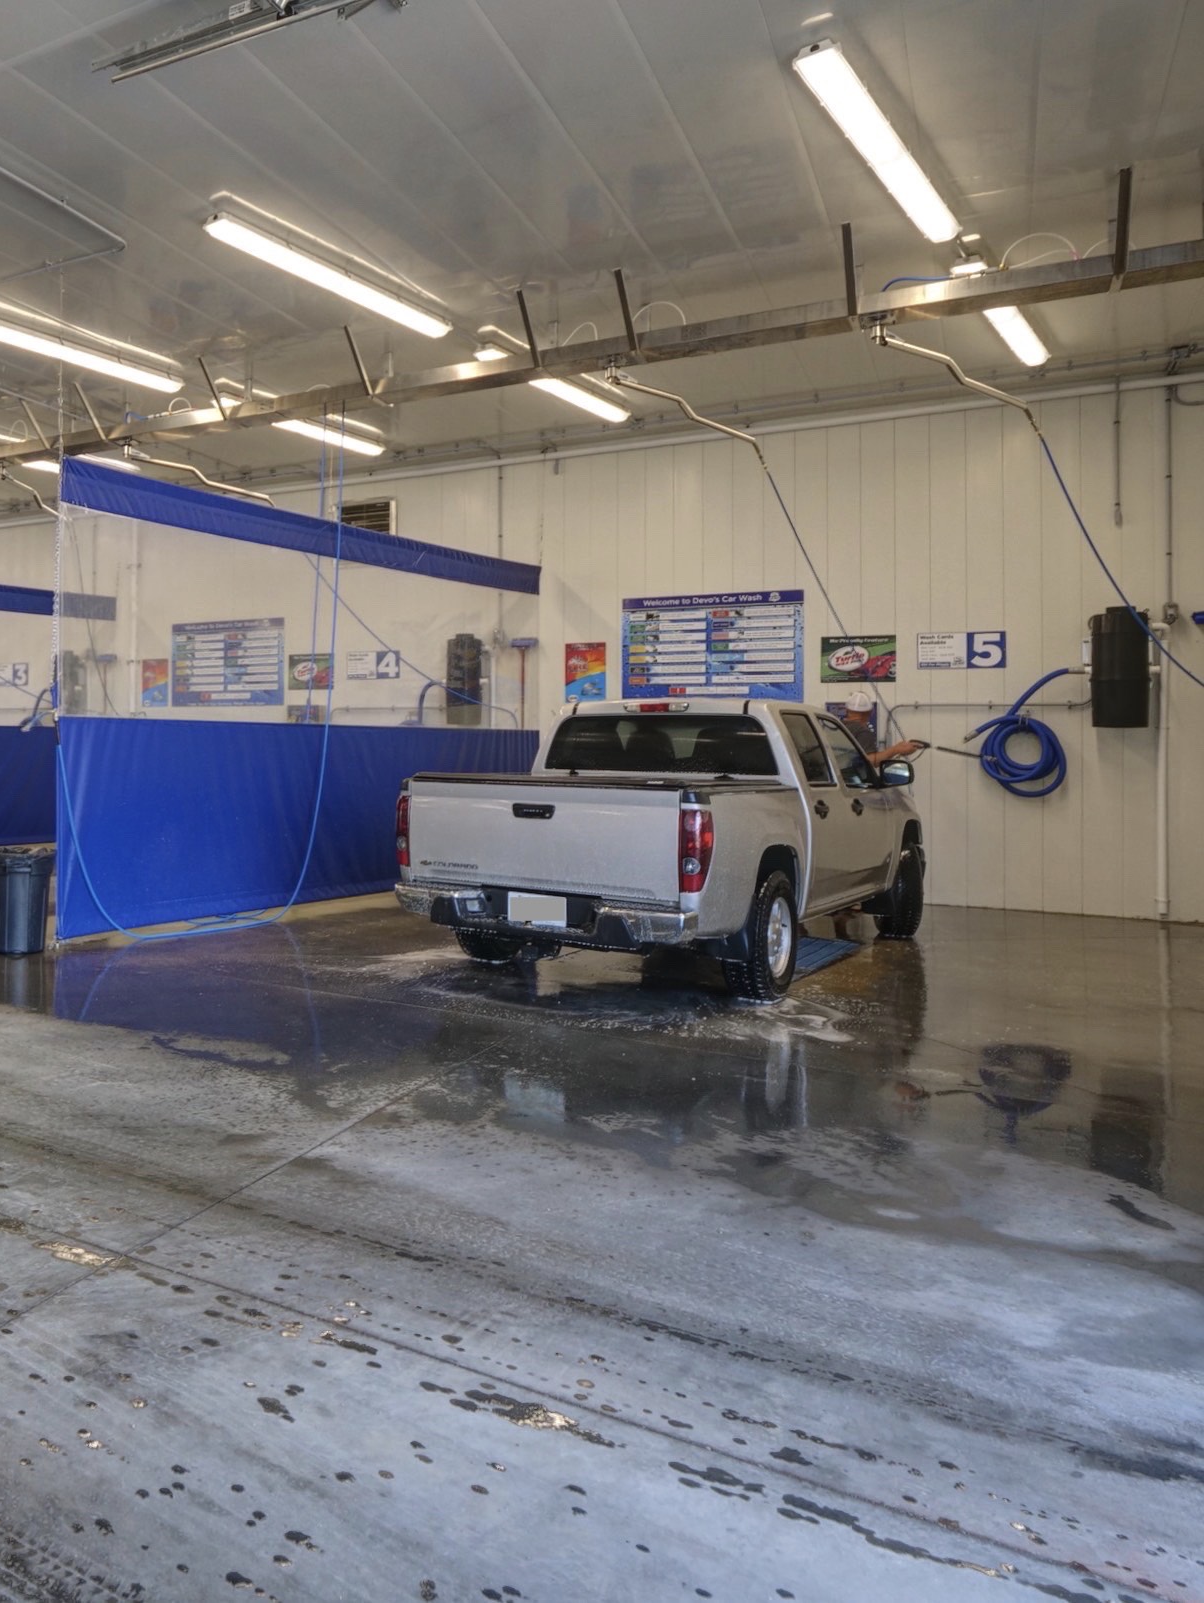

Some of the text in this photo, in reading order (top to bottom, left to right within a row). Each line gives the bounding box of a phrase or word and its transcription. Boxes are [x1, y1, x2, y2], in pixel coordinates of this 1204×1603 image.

[643, 598, 680, 607] Welcome
[692, 596, 720, 605] Devo's
[722, 595, 737, 603] Car
[739, 594, 763, 602] Wash
[970, 633, 1003, 667] 5
[14, 663, 27, 686] 3
[377, 651, 398, 677] 4
[433, 861, 479, 870] COLORADO
